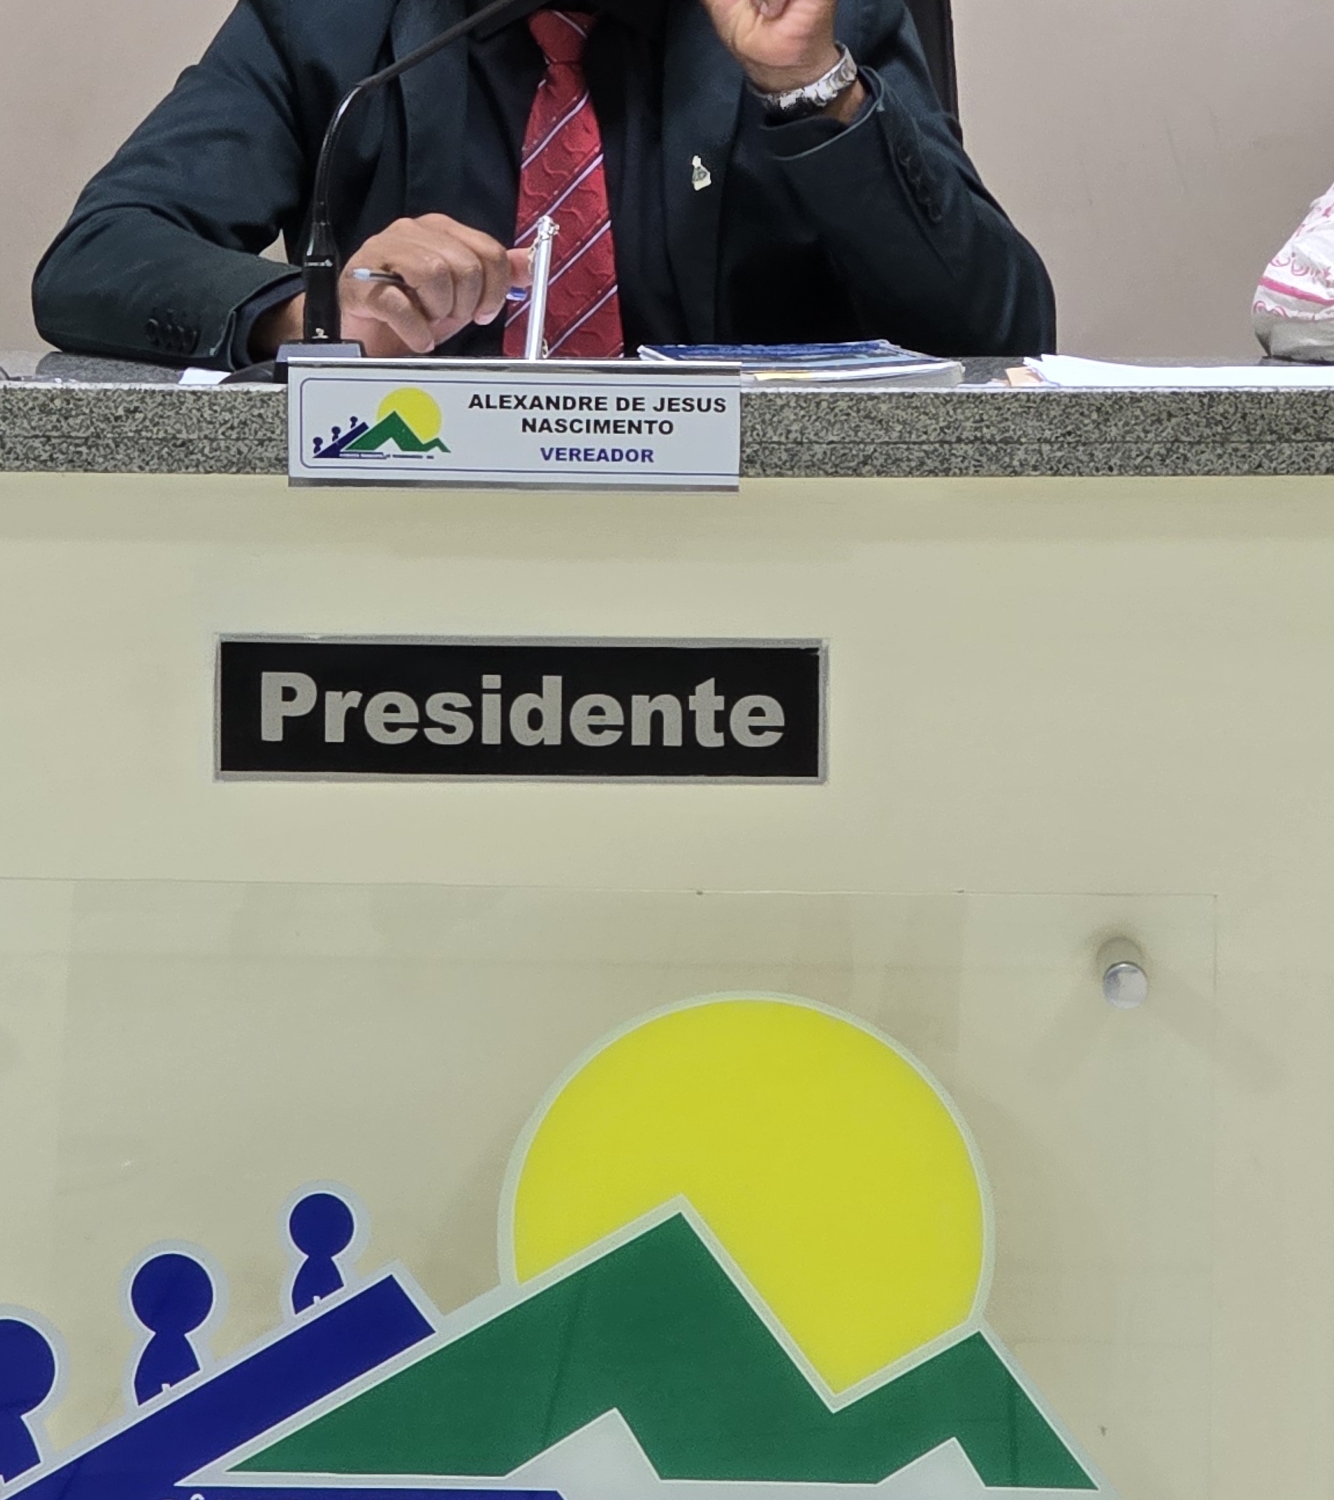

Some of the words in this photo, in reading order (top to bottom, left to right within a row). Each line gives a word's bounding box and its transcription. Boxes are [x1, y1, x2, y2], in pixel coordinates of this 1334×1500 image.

[467, 393, 608, 412] ALEXANDRE
[615, 396, 646, 412] DE
[652, 397, 727, 414] JESUS
[521, 417, 674, 436] NASCIMENTO
[539, 446, 655, 464] VEREADOR
[261, 671, 785, 748] Presidente
